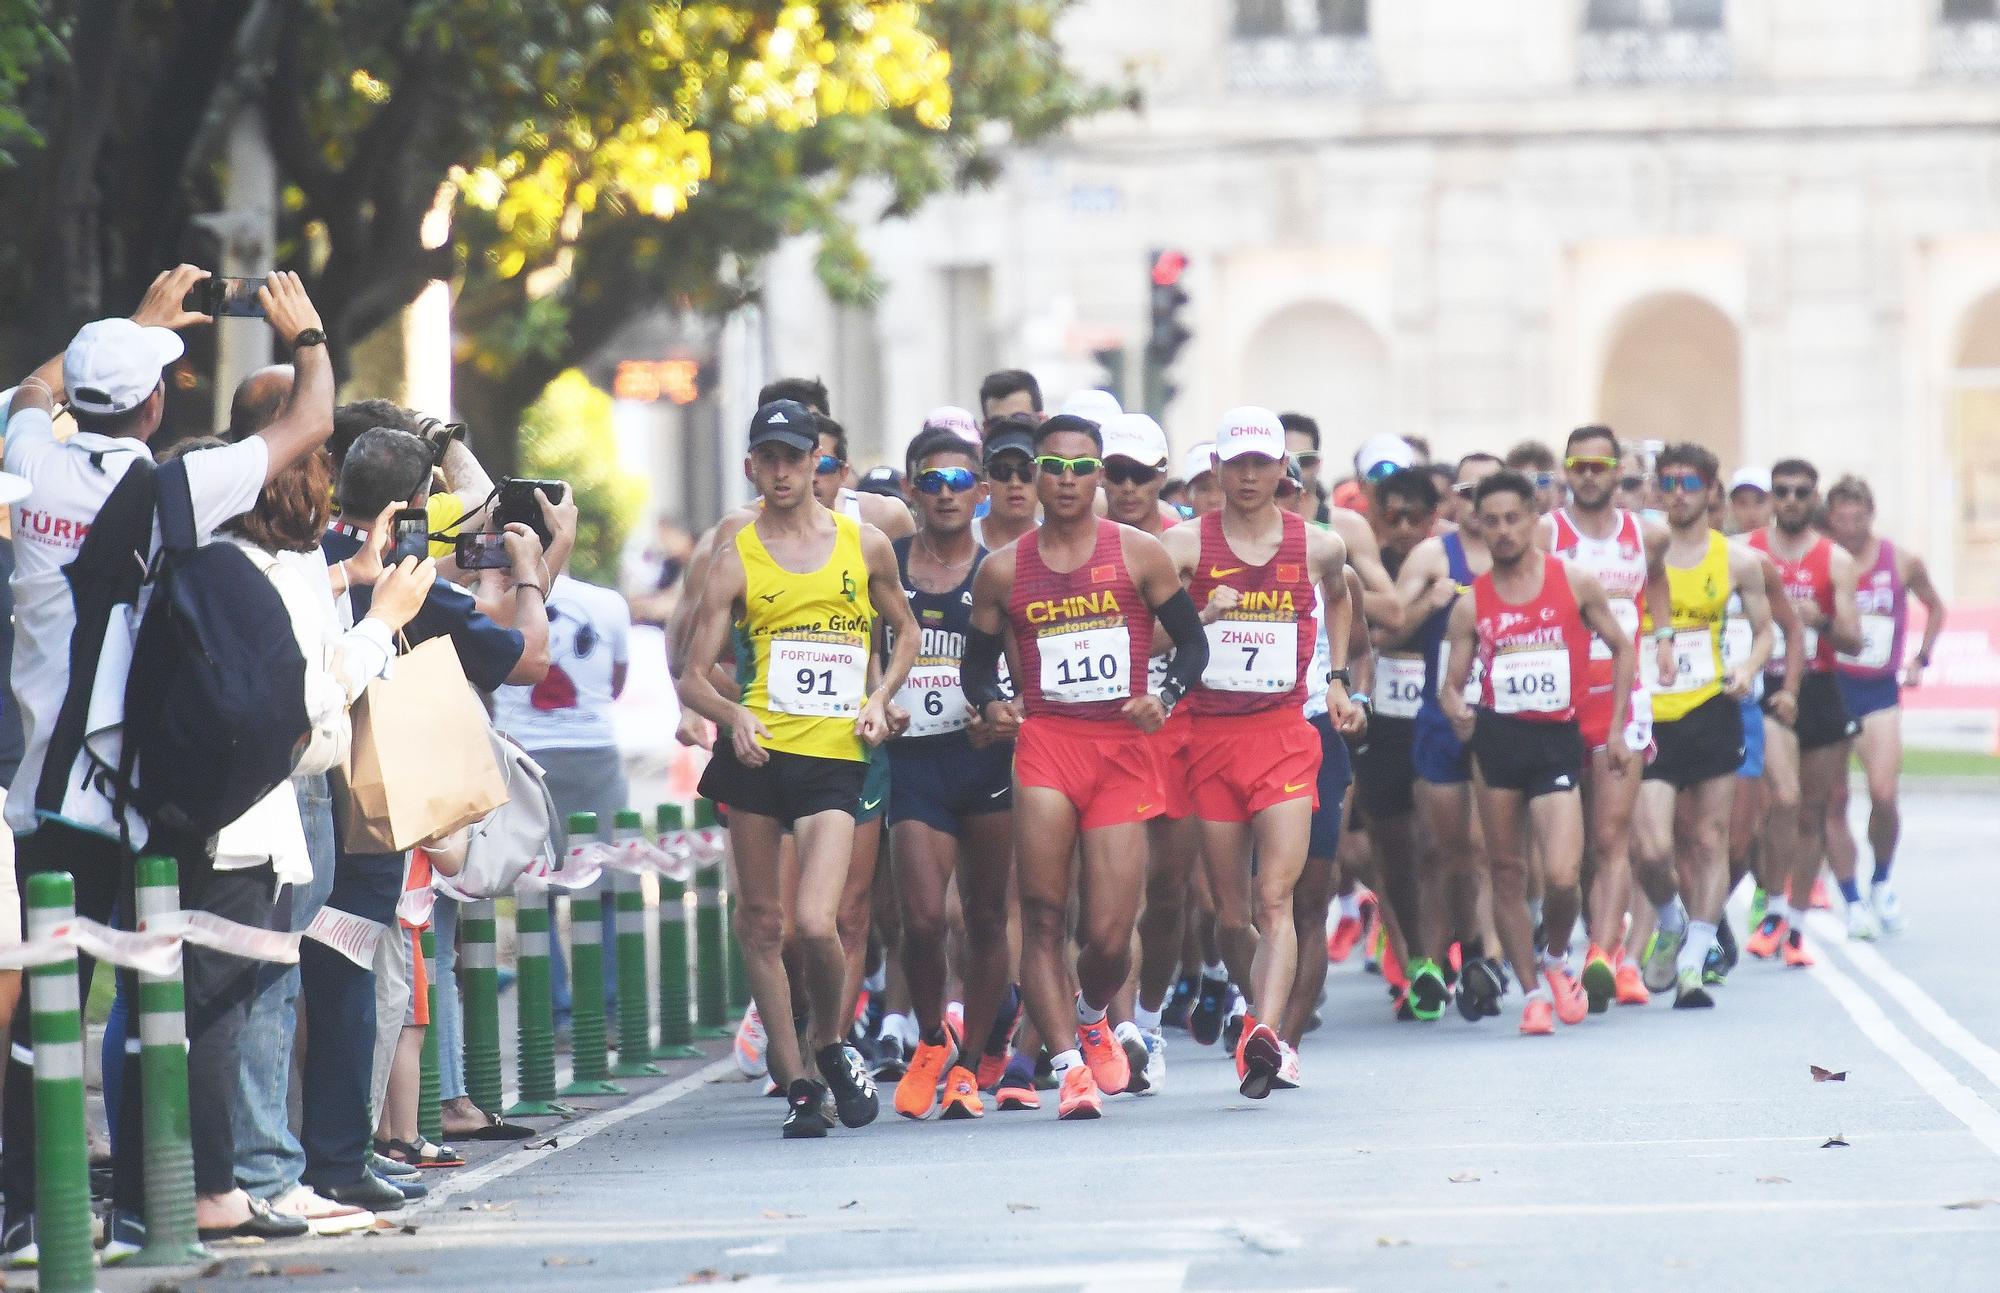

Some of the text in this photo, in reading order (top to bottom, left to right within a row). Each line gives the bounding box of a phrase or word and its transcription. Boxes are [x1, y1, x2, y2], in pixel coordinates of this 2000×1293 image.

[1230, 426, 1272, 437] CHINA
[20, 507, 93, 540] TÜRK
[1026, 590, 1120, 624] CHINA
[1207, 588, 1295, 611] HINA
[1074, 639, 1090, 651] HE
[1221, 630, 1276, 645] ZHANG
[780, 649, 853, 665] FORTUNATO
[1241, 646, 1260, 672] 7
[906, 674, 963, 689] INTADO
[1057, 653, 1118, 686] 110
[796, 668, 838, 696] 91
[1505, 672, 1557, 696] 108
[924, 690, 944, 716] 6
